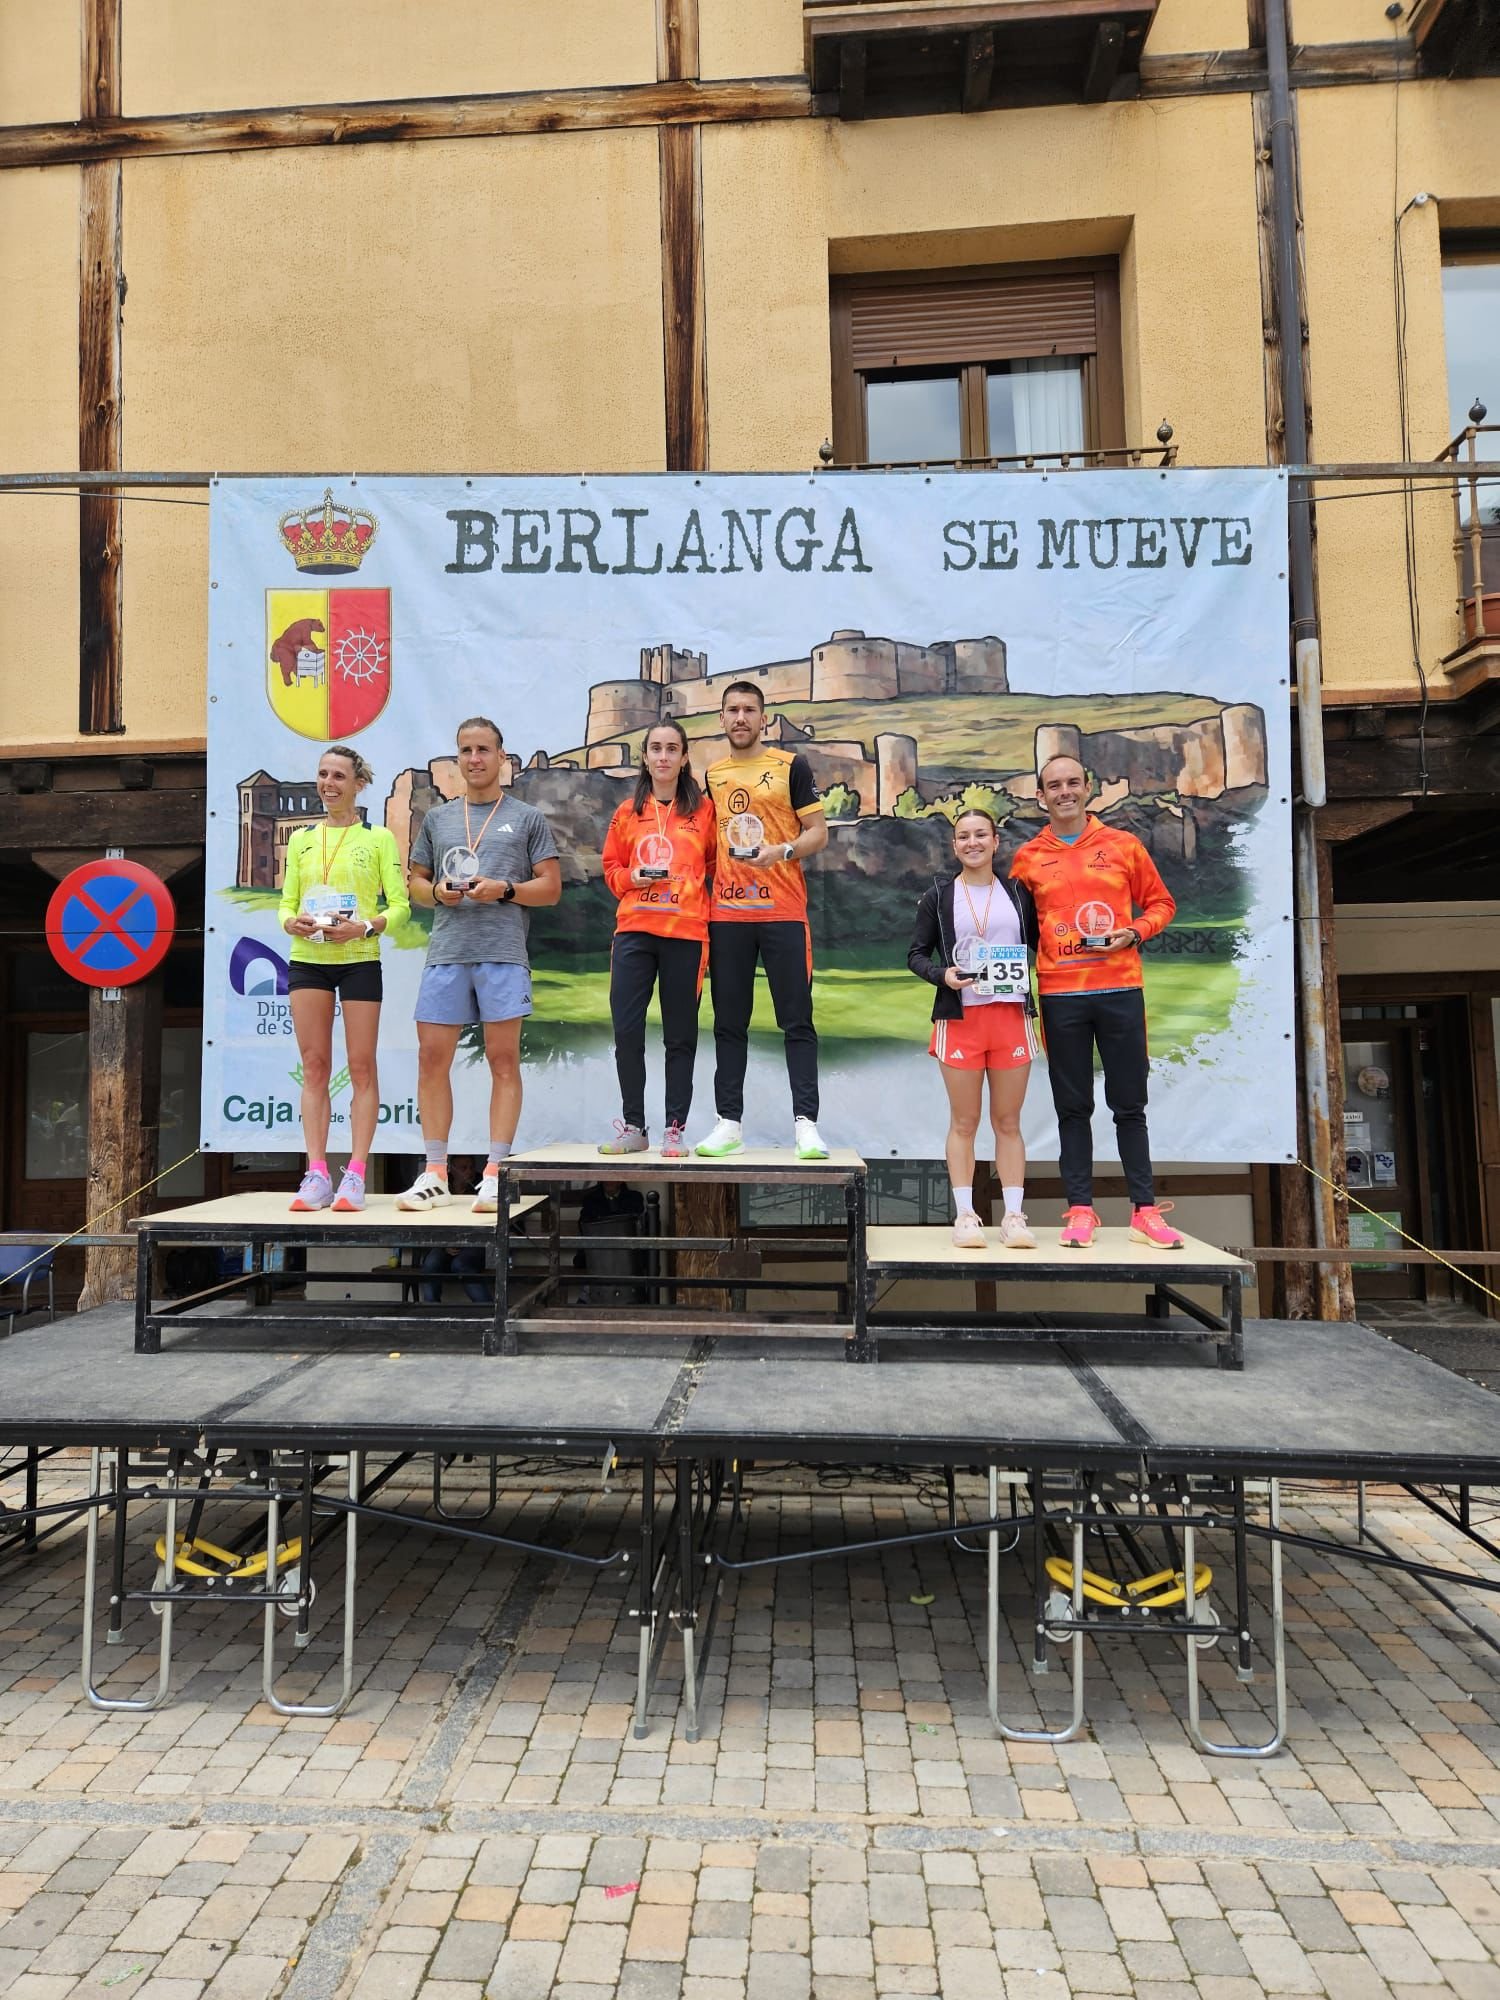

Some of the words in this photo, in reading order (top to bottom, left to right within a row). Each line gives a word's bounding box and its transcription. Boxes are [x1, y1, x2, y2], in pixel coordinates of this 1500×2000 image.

[444, 508, 872, 574] BERLANGA
[942, 519, 1018, 571] SE
[1037, 518, 1253, 570] MUEVE
[720, 881, 771, 899] ideda
[1058, 940, 1084, 956] ide
[257, 1018, 277, 1035] de
[223, 1095, 293, 1129] Caja
[330, 1112, 345, 1123] de
